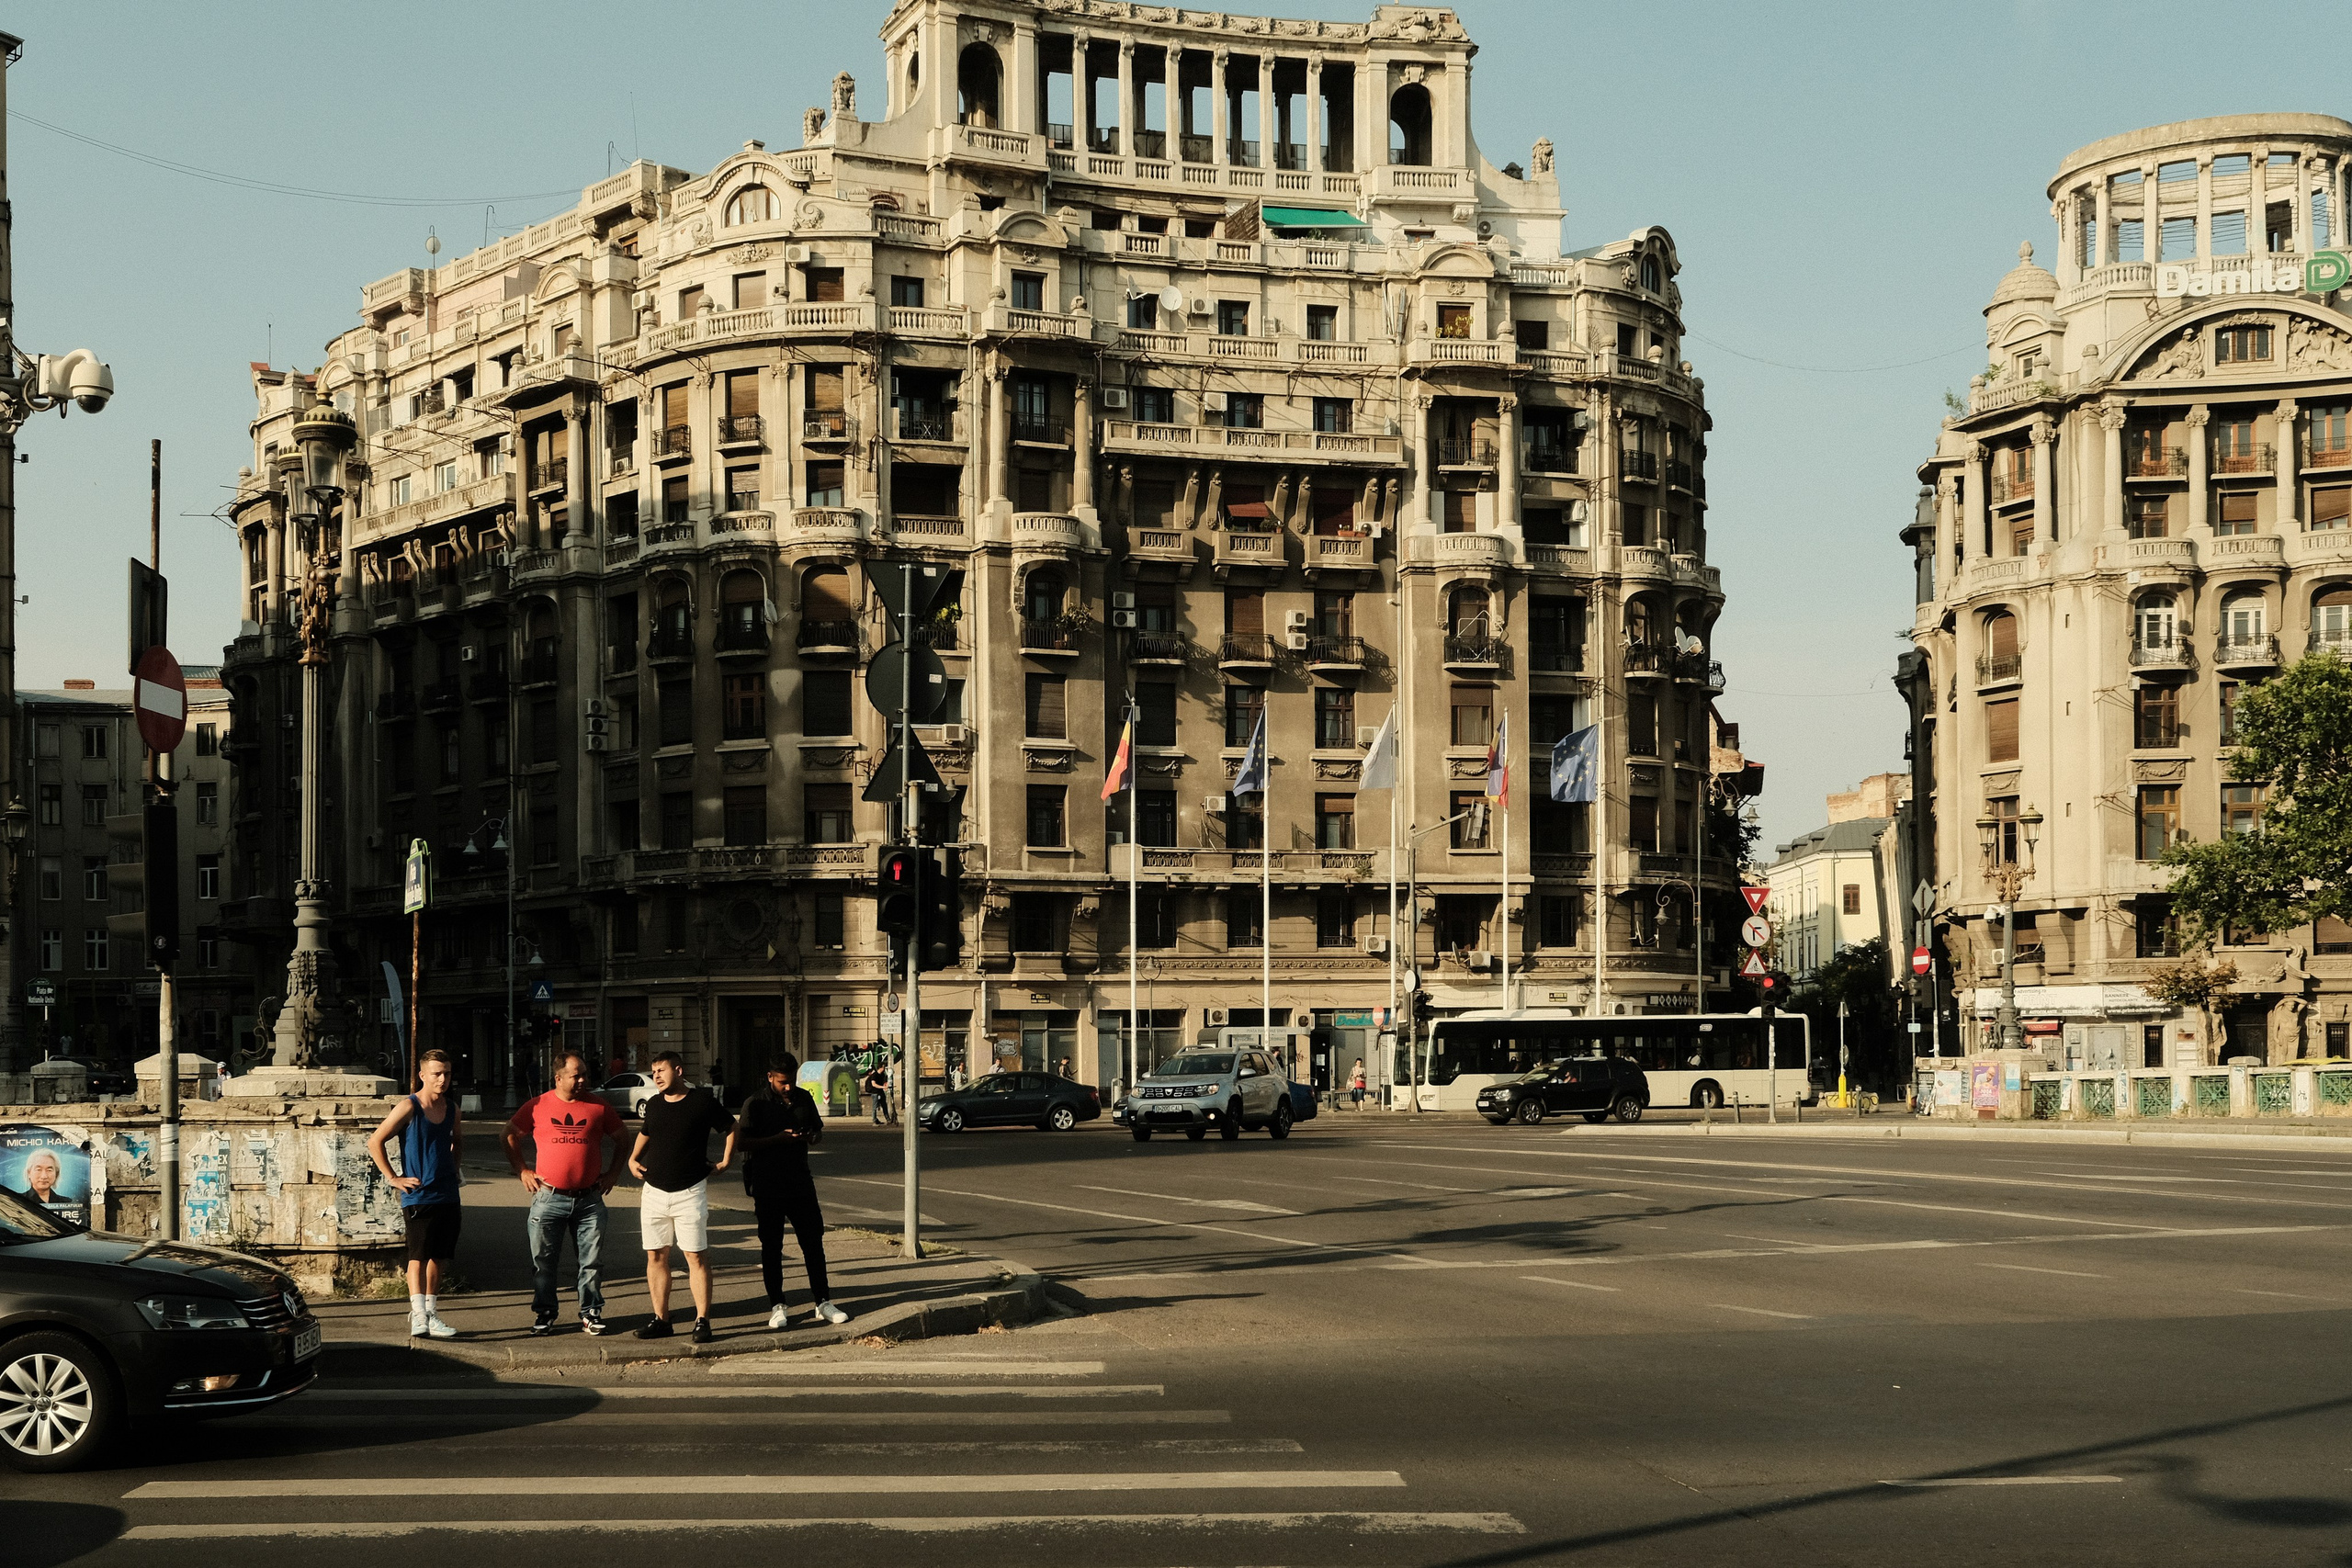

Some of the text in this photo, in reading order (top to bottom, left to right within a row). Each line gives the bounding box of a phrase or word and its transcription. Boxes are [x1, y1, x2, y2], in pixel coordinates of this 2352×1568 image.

[2156, 260, 2300, 298] Damila
[6, 1138, 43, 1147] MICHIO
[551, 1135, 589, 1145] adidas
